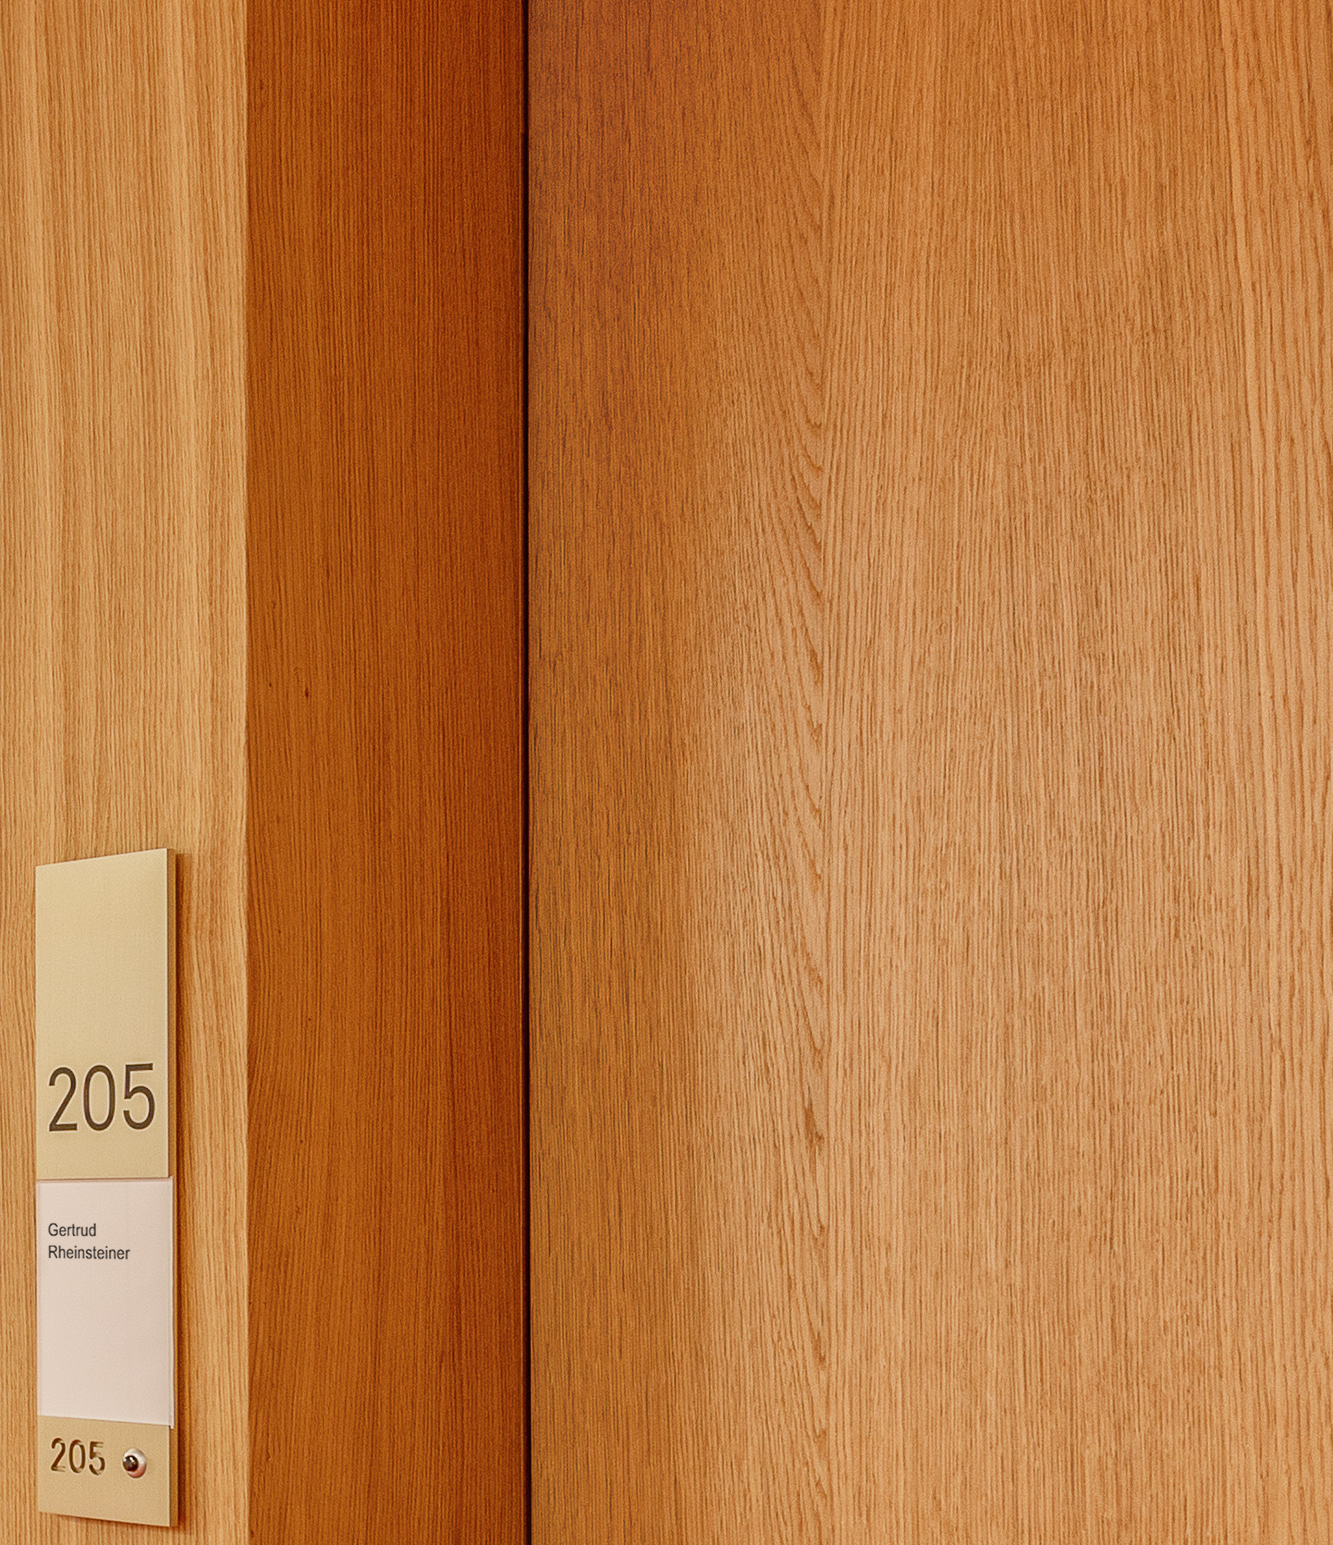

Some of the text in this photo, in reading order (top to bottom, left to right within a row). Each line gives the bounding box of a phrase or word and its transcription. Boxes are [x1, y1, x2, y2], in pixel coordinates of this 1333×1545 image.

[48, 1062, 155, 1132] 205
[48, 1222, 97, 1237] Gertrud
[48, 1245, 131, 1260] Rheinsteiner
[50, 1437, 106, 1476] 205
